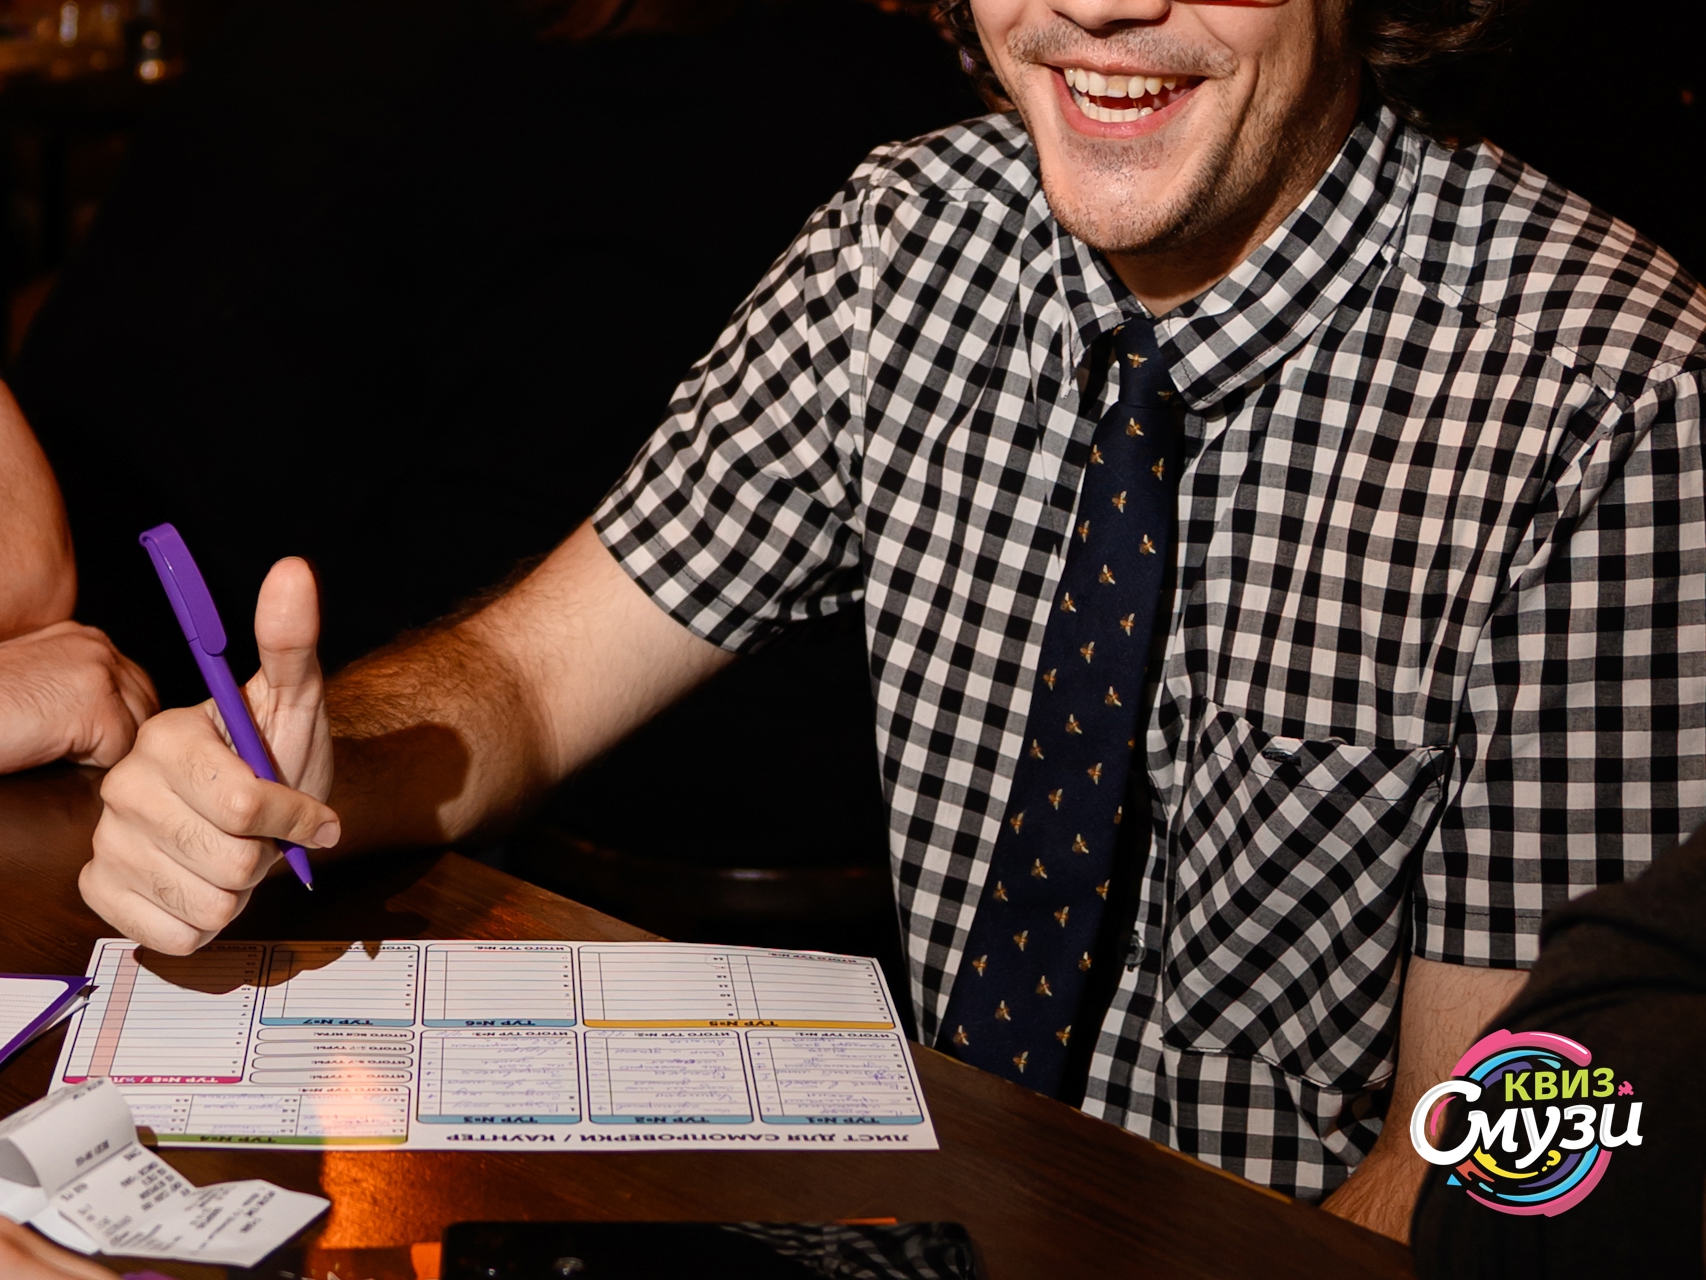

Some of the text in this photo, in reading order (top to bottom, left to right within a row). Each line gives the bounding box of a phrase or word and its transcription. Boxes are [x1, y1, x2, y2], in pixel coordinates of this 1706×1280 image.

[849, 1031, 889, 1039] ИТОГО
[501, 1116, 538, 1124] ТУР
[673, 1116, 709, 1124] ТУР
[843, 1116, 879, 1124] ТУР
[446, 1133, 554, 1143] КАУНТЕР
[580, 1133, 779, 1143] САМОПРОВЕРКИ
[788, 1133, 835, 1143] ДЛЯ
[844, 1133, 908, 1143] ЛИСТ
